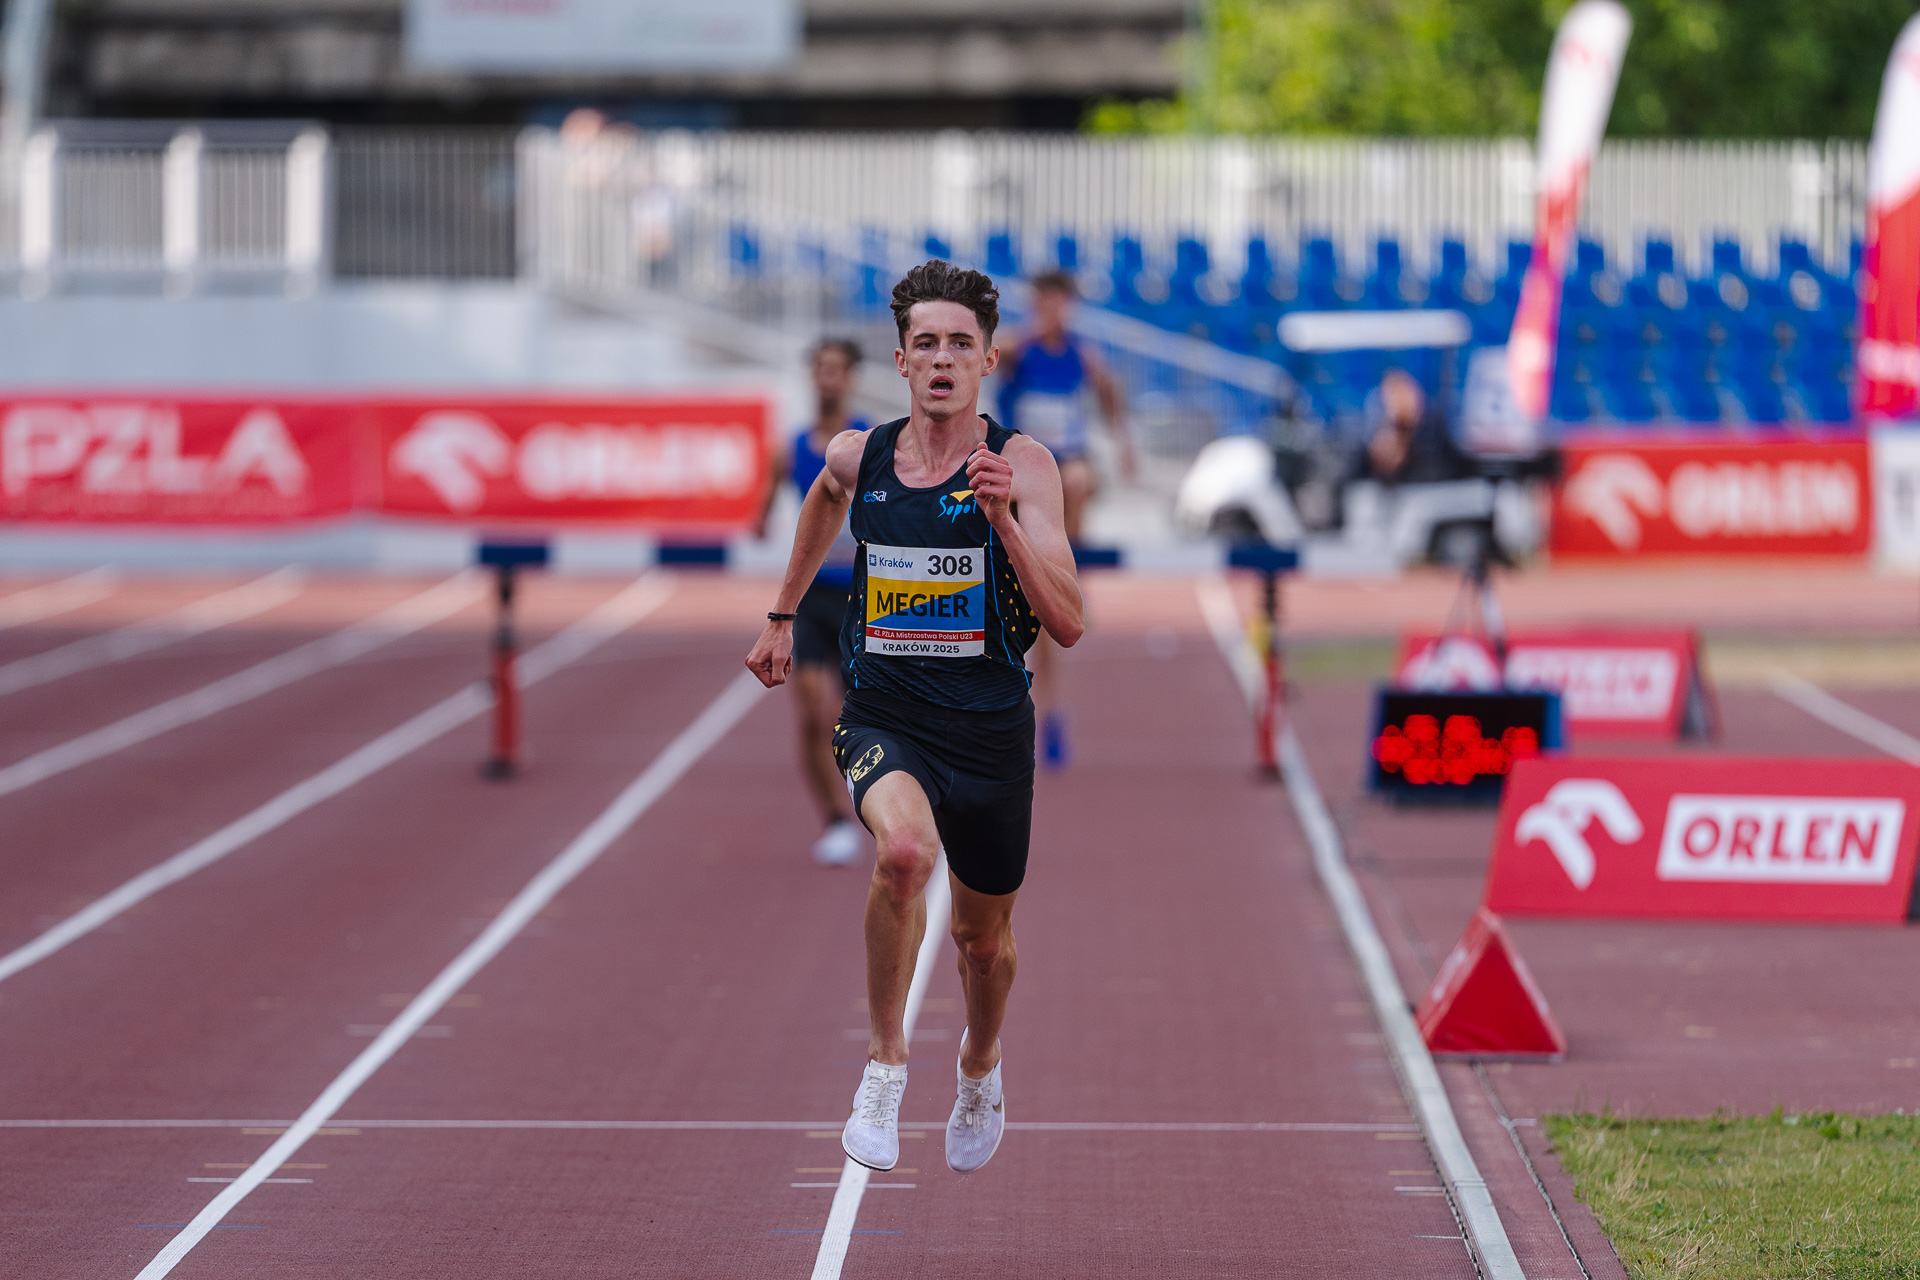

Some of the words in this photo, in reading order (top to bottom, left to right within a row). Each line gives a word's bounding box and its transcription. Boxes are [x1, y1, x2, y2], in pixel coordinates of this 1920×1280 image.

[2, 405, 311, 497] PZLA
[879, 557, 914, 569] Kraków
[927, 554, 973, 576] 308
[876, 590, 970, 618] MEGIER
[873, 629, 881, 637] 42.
[882, 630, 895, 638] PZLA
[882, 641, 931, 653] KRAKÓW
[933, 644, 960, 654] 2025
[1682, 815, 1881, 863] ORLEN
